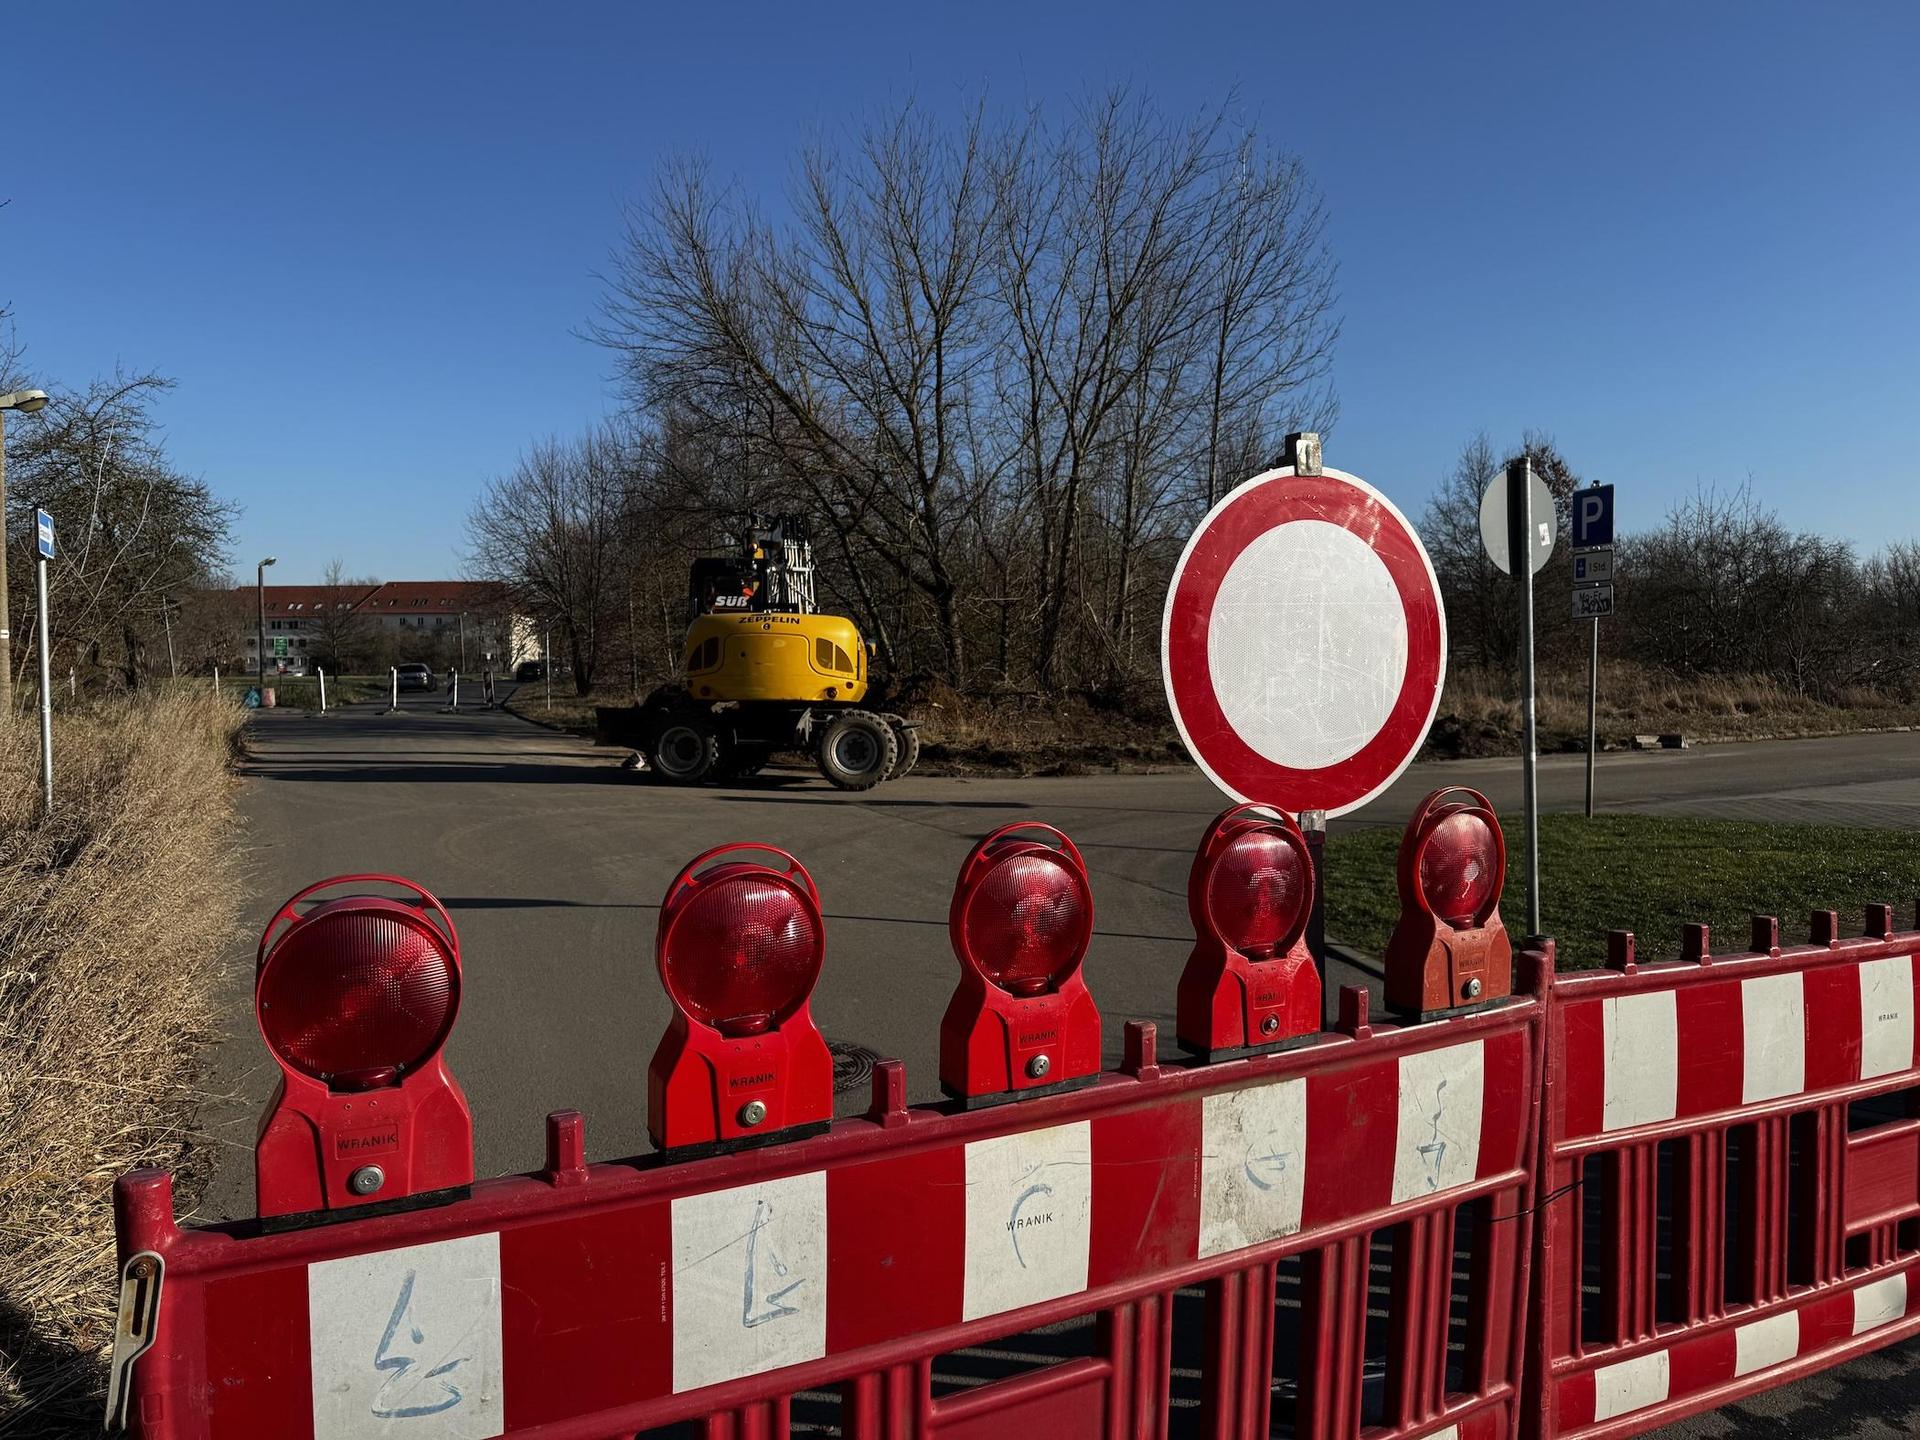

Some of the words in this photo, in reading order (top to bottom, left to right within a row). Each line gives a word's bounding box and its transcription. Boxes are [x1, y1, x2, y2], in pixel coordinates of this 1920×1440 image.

[1581, 495, 1604, 541] P
[738, 616, 800, 625] ZEPPELIN
[1019, 1030, 1057, 1044] WRANIK
[729, 1072, 776, 1088] WRANIK
[336, 1132, 397, 1150] WRANIK
[1005, 1211, 1054, 1232] WRANIK
